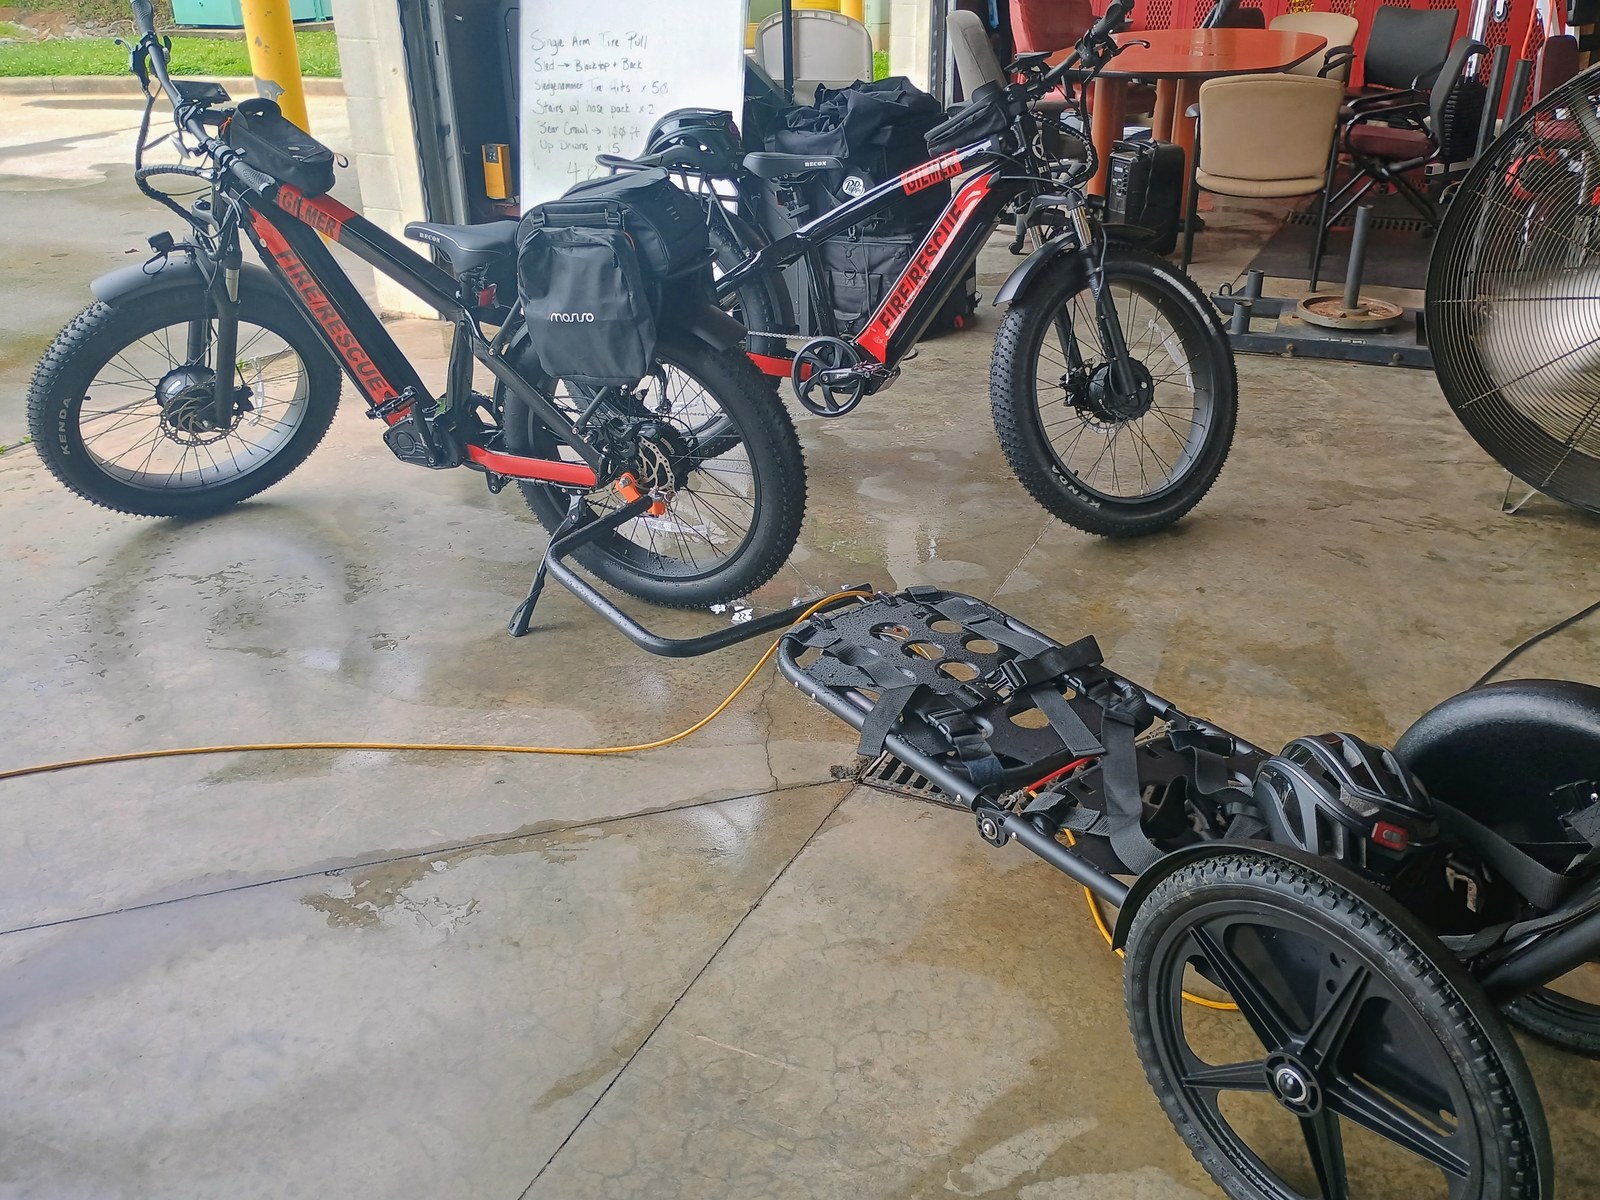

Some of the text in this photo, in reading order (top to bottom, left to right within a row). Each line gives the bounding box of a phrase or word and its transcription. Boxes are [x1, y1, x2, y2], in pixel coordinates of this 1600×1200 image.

[572, 34, 590, 47] Arm
[599, 31, 620, 47] Tire
[626, 31, 648, 49] Pull
[534, 57, 555, 72] Sled
[622, 57, 642, 71] Back
[532, 99, 564, 115] Stairs
[540, 139, 554, 153] Up
[905, 153, 962, 192] GILMER
[281, 190, 337, 237] GILMER
[419, 232, 441, 243] RECON
[879, 203, 963, 329] FIRE/RESCUE
[275, 250, 387, 392] FIRE/RESCUE
[59, 398, 72, 455] KENDA
[1051, 464, 1101, 509] KENDA
